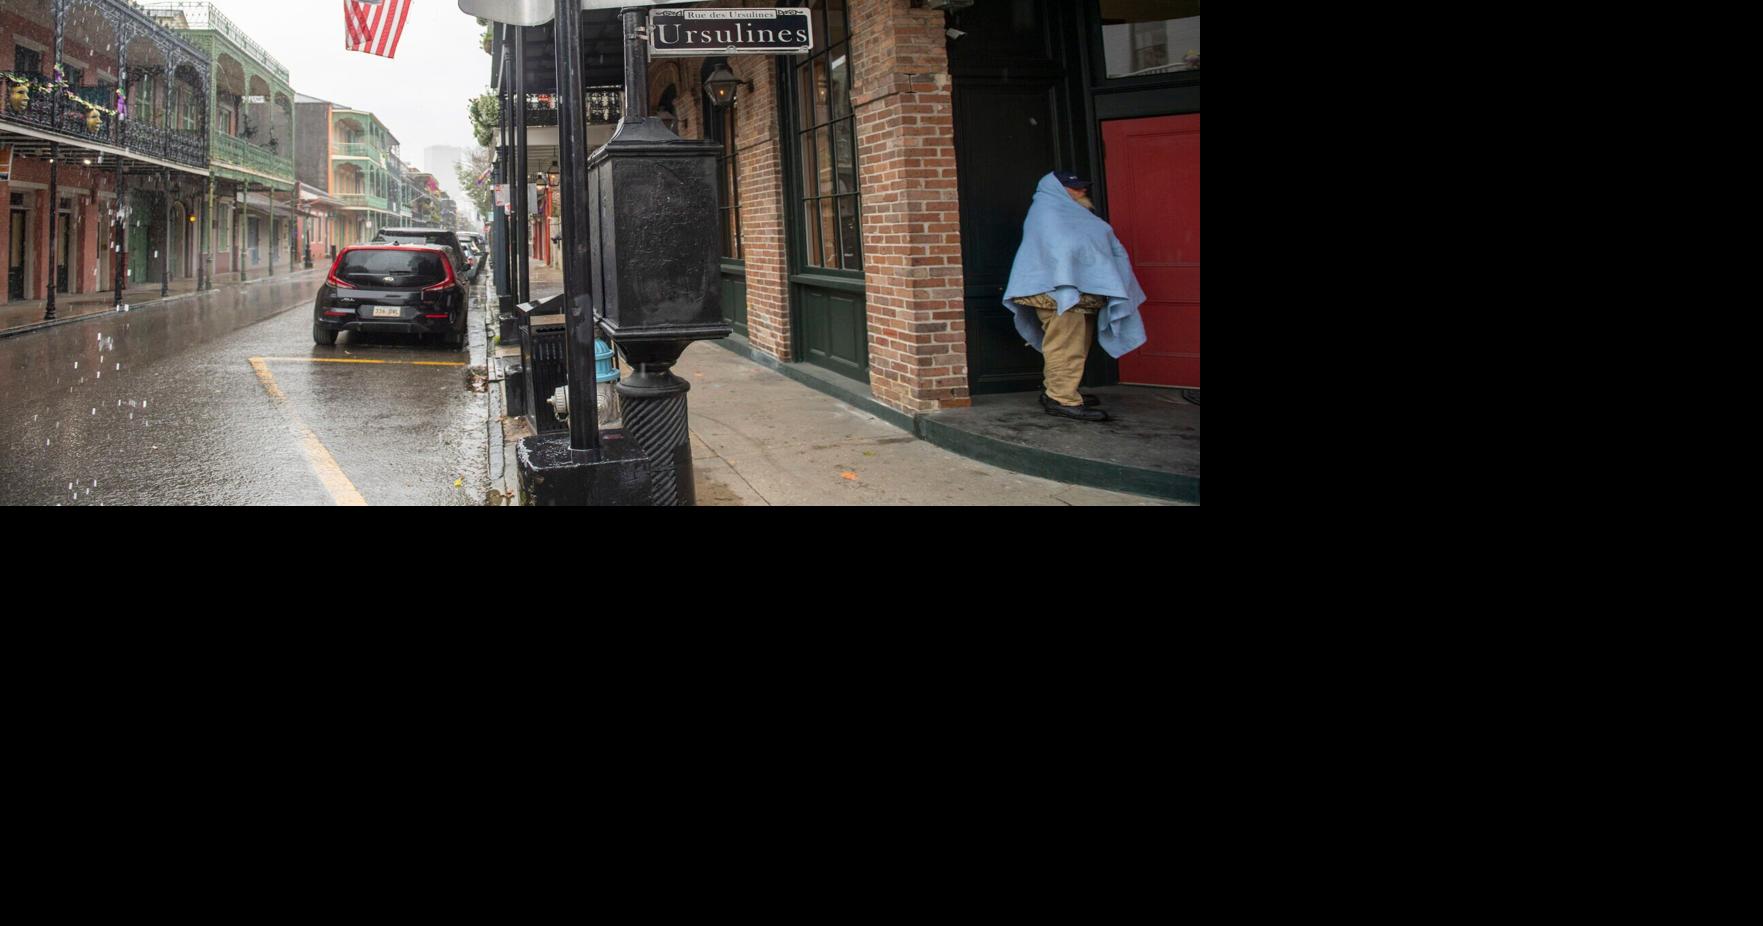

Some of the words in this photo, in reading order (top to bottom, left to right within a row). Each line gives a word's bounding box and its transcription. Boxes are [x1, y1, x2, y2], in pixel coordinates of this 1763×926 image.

[687, 11, 705, 19] Rue
[709, 10, 726, 19] des
[729, 10, 775, 19] Ursulines
[658, 23, 808, 44] Ursulines
